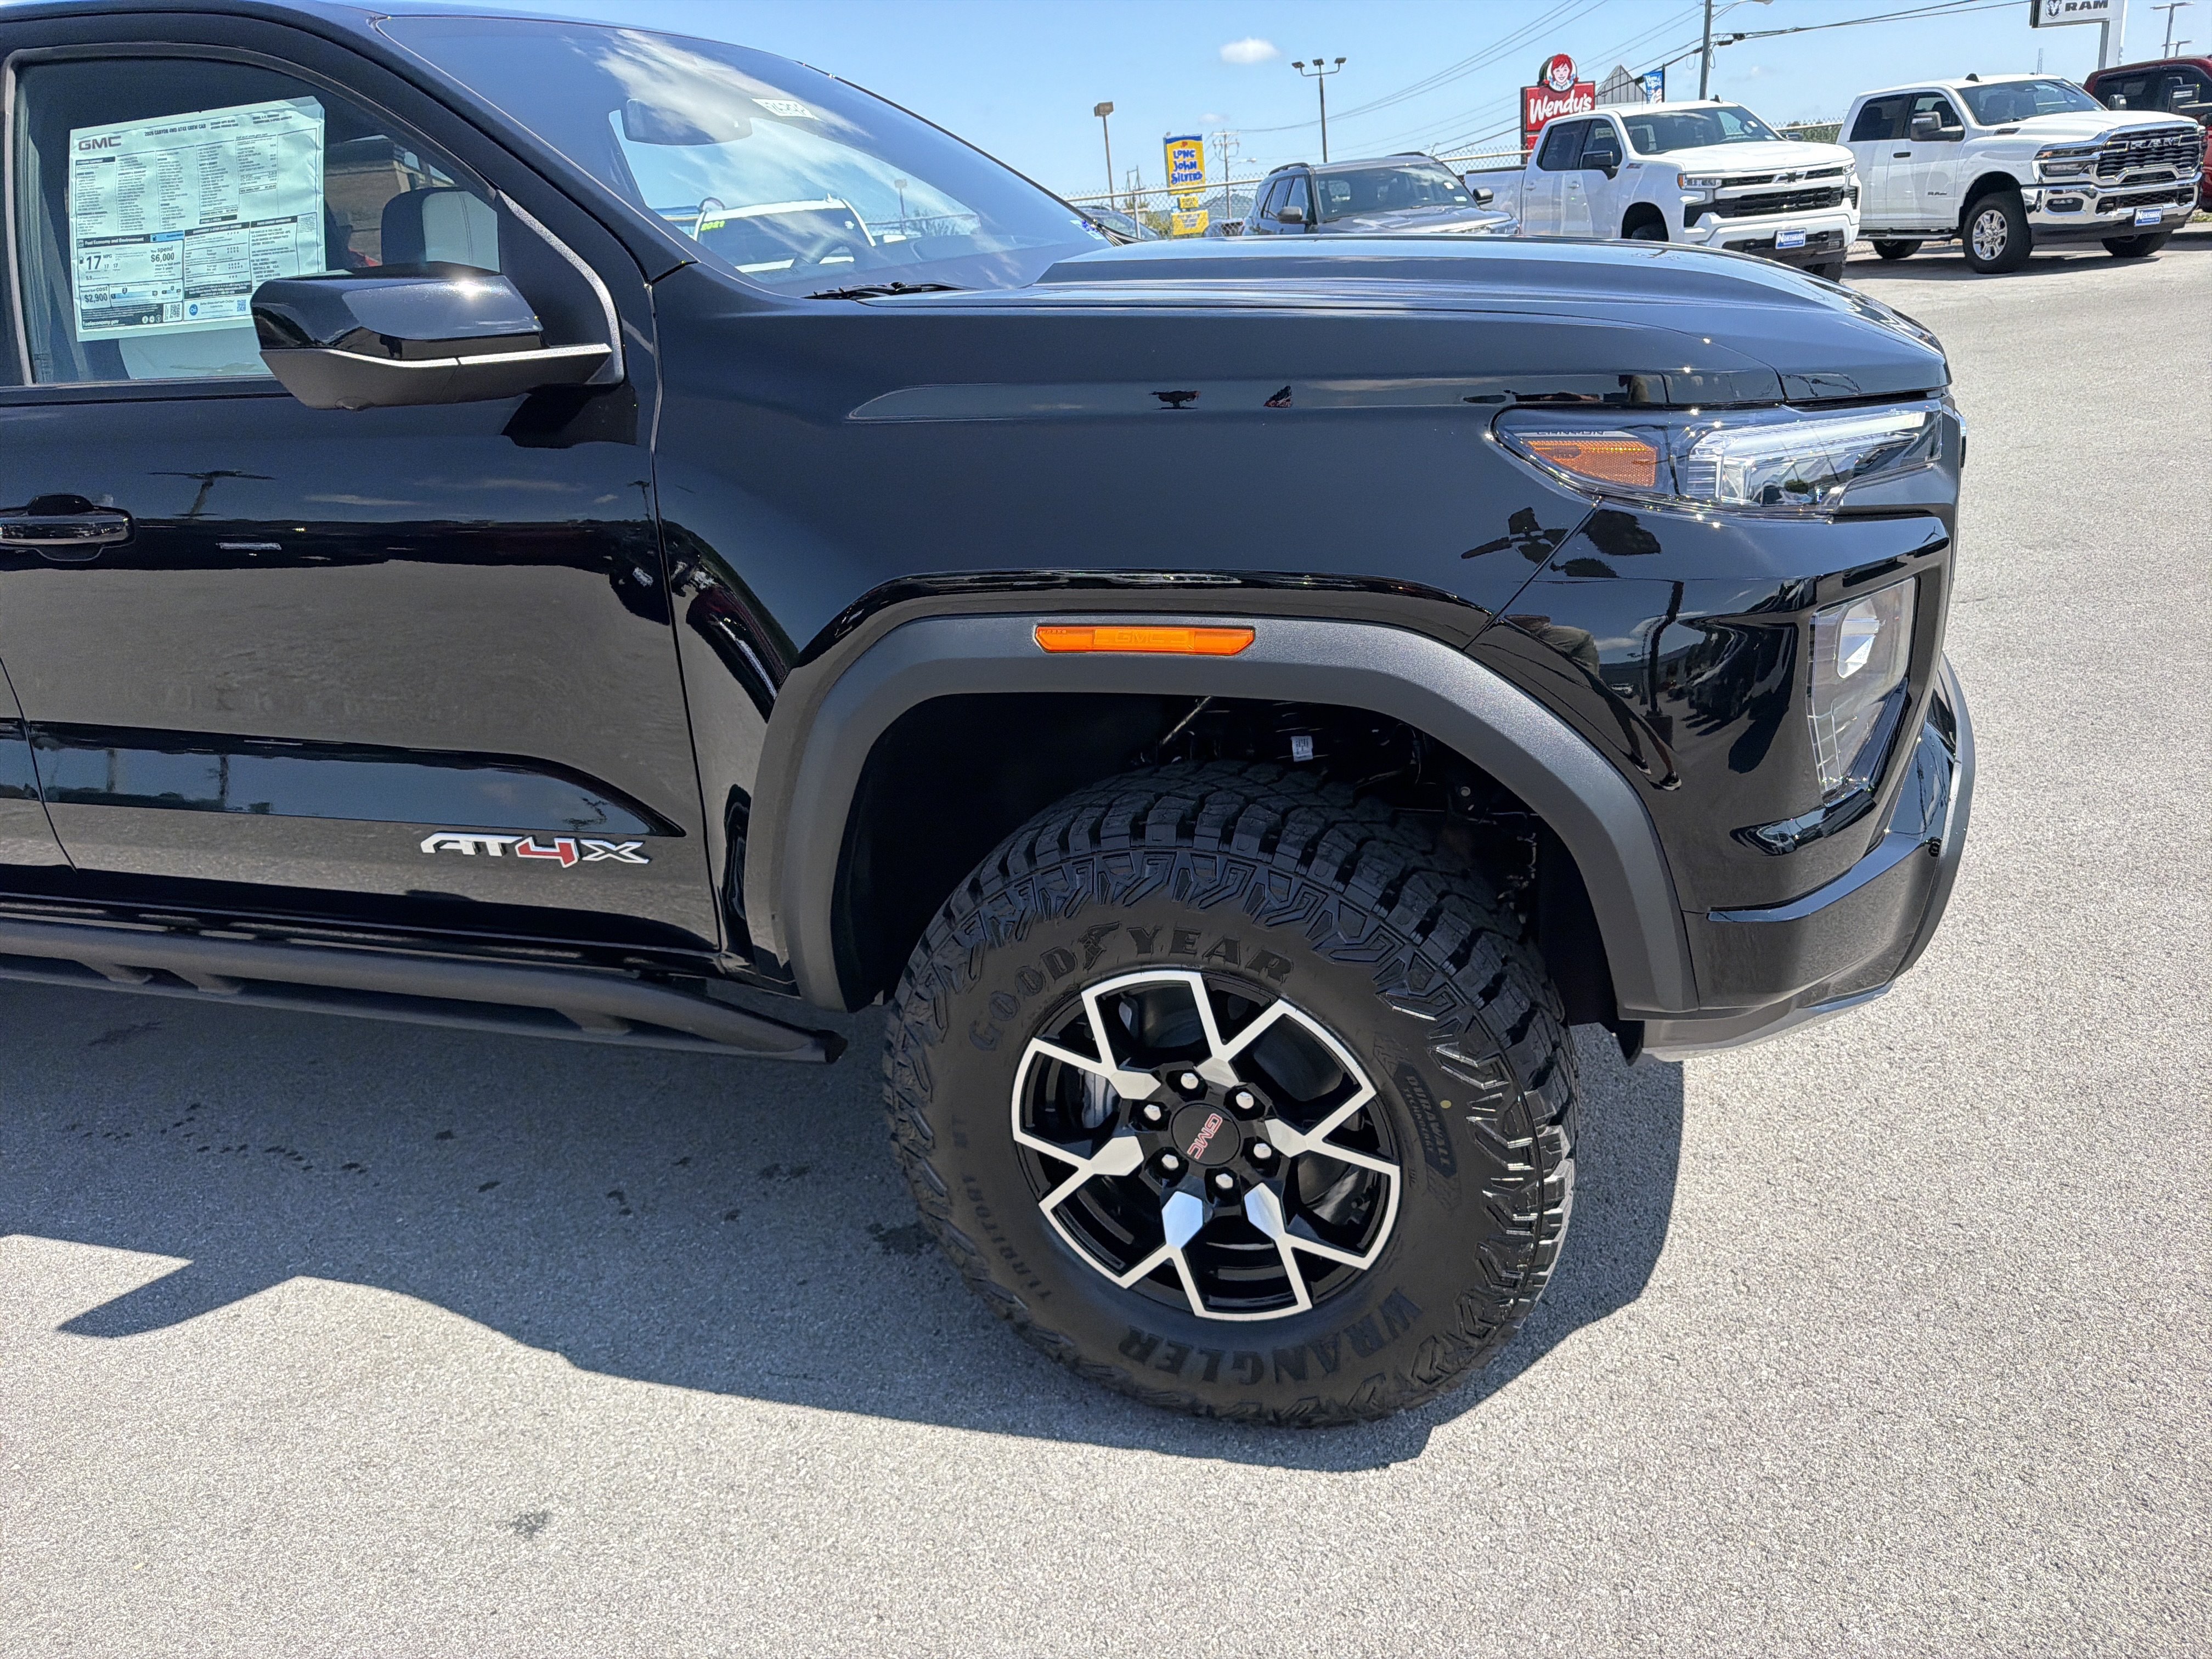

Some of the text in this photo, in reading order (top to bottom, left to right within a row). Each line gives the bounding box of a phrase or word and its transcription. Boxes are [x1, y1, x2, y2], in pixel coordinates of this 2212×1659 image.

[2065, 0, 2108, 12] RAM
[1530, 89, 1592, 125] Wendy's
[78, 136, 122, 151] GMC
[1173, 150, 1195, 159] LONG
[157, 245, 173, 253] spend
[86, 255, 101, 270] 17
[151, 252, 174, 263] $6,000
[84, 292, 108, 303] $2,900
[1114, 630, 1170, 644] GMC
[420, 832, 652, 868] AT4X
[1406, 1075, 1451, 1165] DURAWALL
[1187, 1113, 1223, 1160] GMC
[1118, 1287, 1425, 1385] WRANGLER
